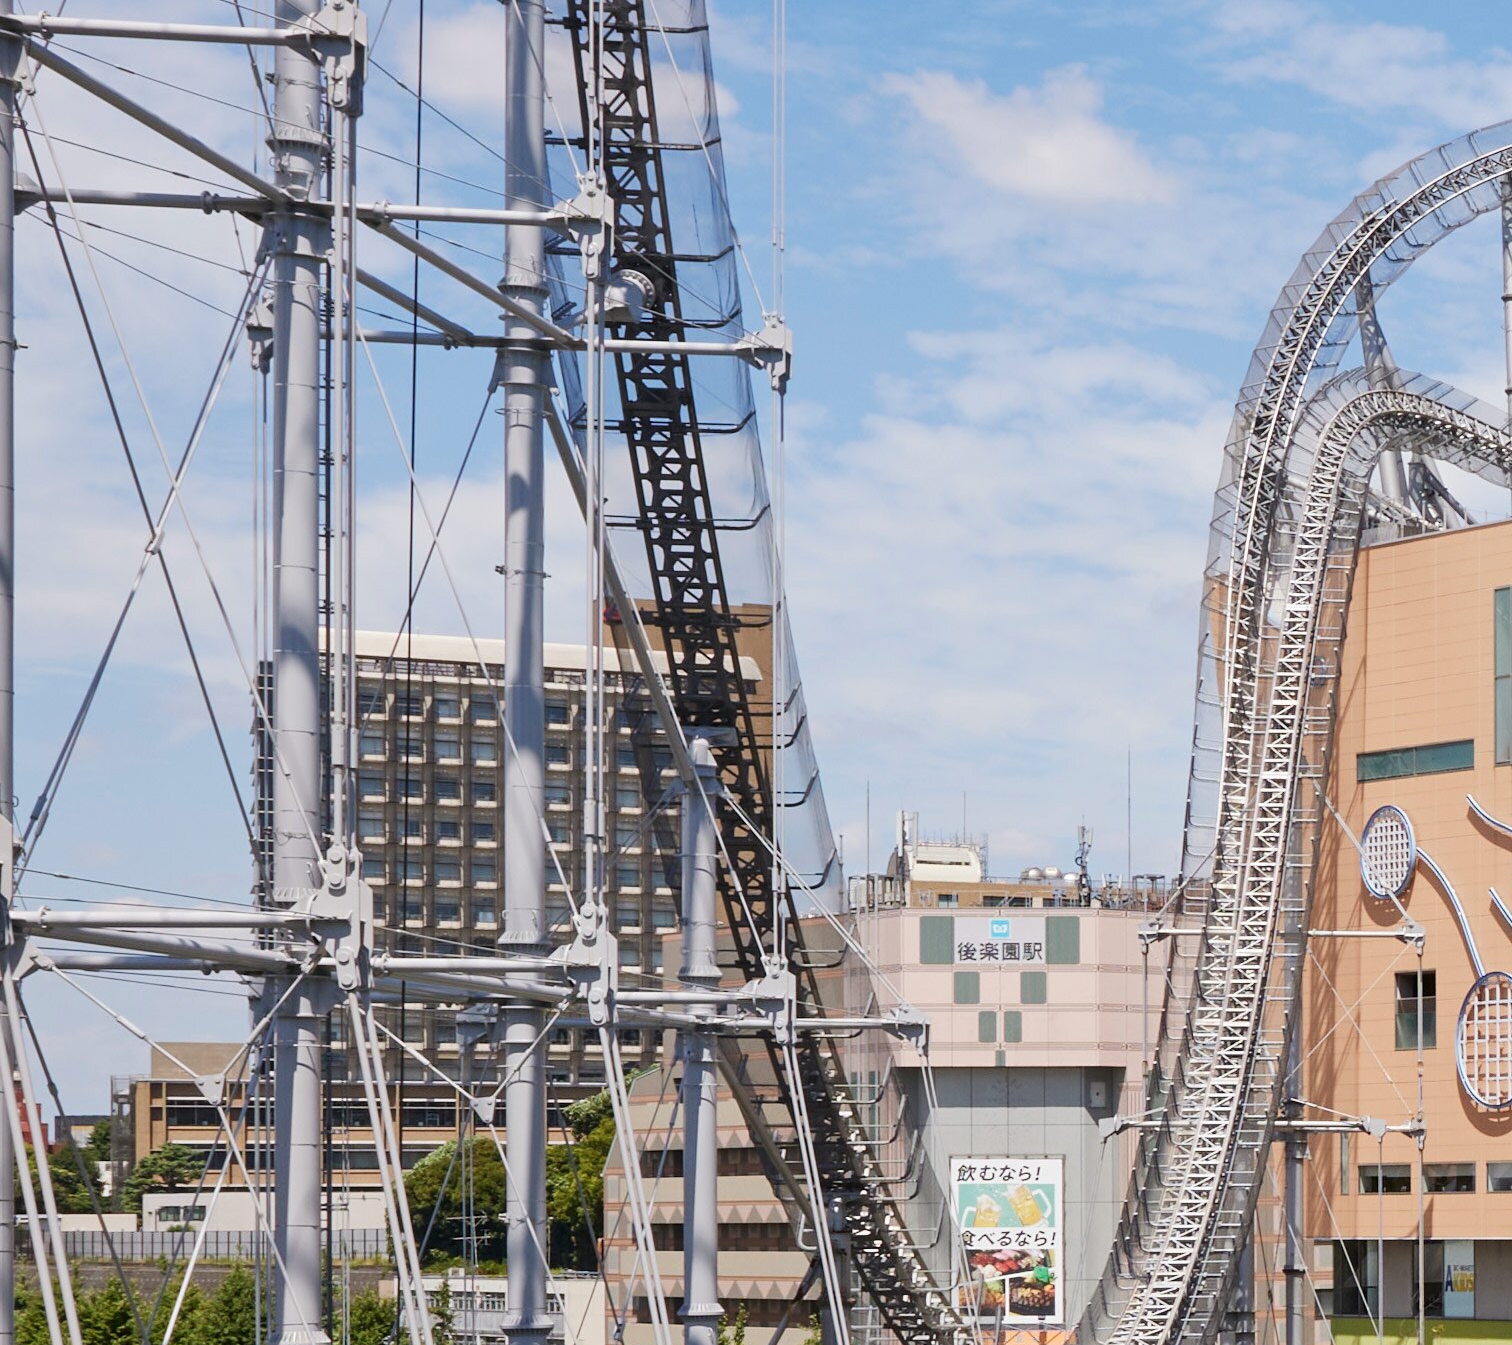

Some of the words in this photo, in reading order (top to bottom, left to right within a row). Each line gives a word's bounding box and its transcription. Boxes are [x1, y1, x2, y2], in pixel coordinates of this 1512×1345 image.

[957, 941, 1043, 961] 後楽園駅
[957, 1164, 1041, 1182] 飲むなら!
